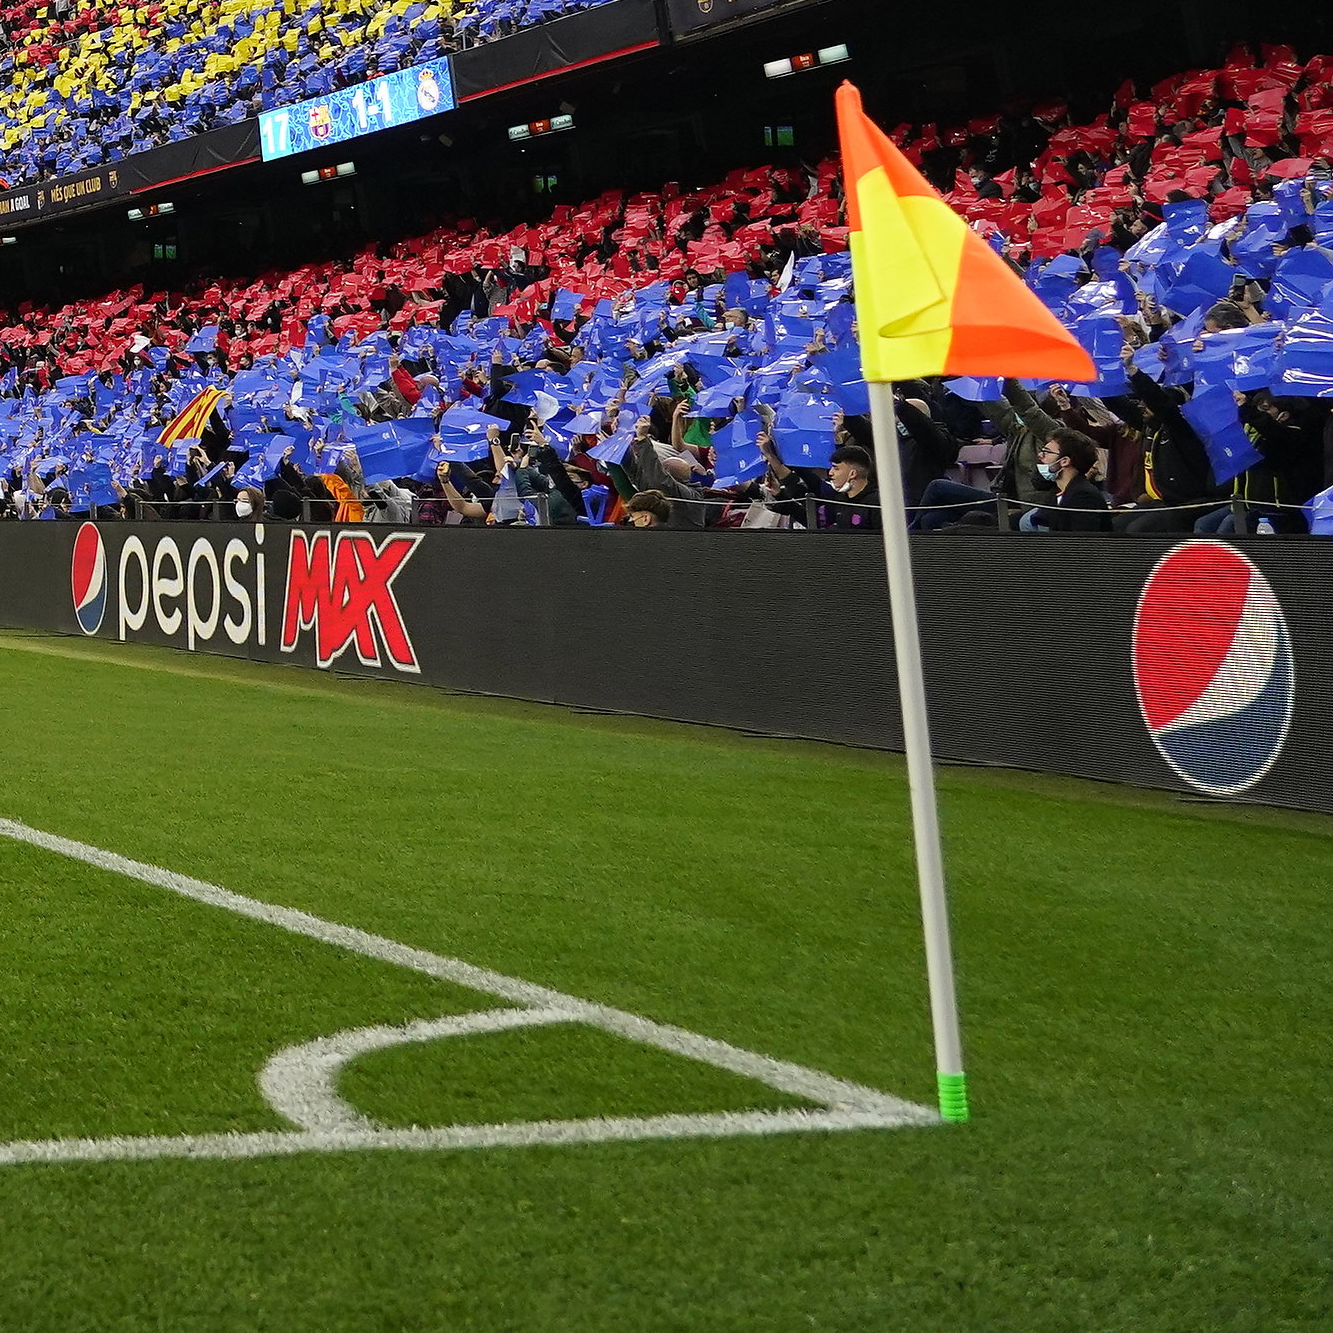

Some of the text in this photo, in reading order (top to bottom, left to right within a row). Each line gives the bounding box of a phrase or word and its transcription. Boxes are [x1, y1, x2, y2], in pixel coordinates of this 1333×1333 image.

[352, 81, 392, 128] 1-1
[263, 112, 289, 153] 17
[10, 197, 15, 210] A
[15, 193, 29, 209] GOAL
[50, 176, 101, 201] MÉS QUE UN CLUB
[119, 523, 425, 674] pepsi MAX
